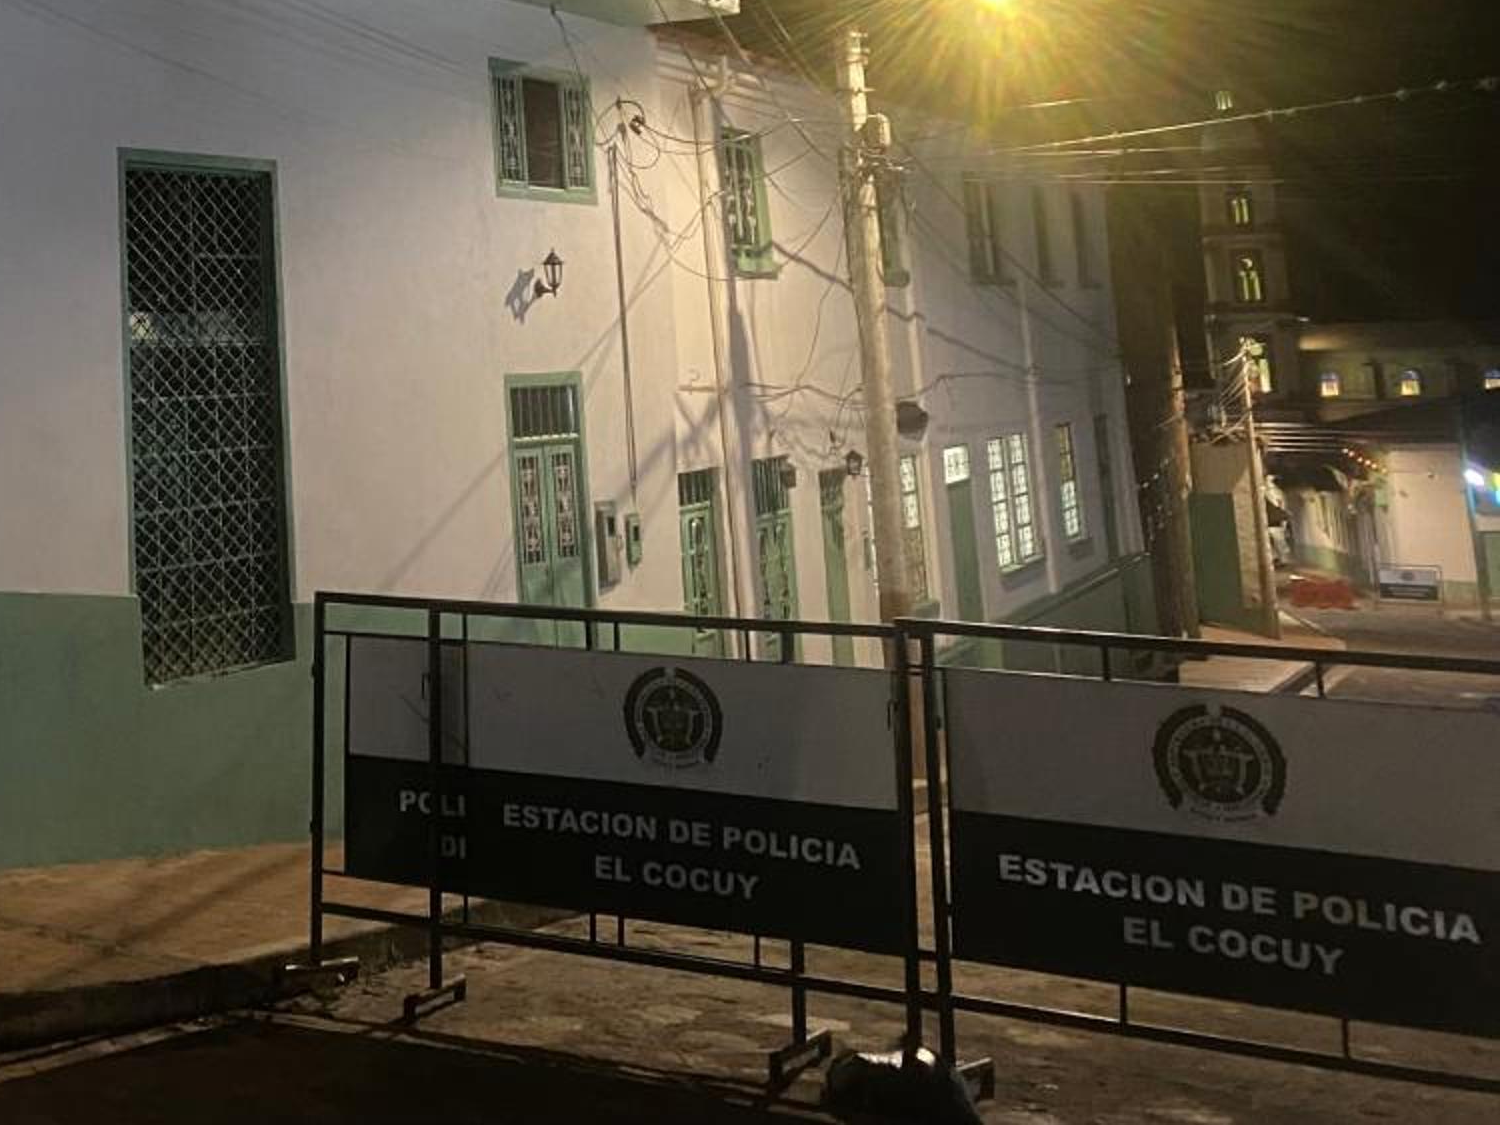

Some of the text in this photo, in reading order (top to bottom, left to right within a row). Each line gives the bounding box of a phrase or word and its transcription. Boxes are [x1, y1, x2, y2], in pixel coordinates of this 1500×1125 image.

[503, 804, 861, 870] ESTACION DE POLICIA
[595, 855, 759, 900] EL COCUY
[998, 854, 1482, 945] ESTACION DE POLICIA
[1123, 917, 1344, 975] EL COCUY
